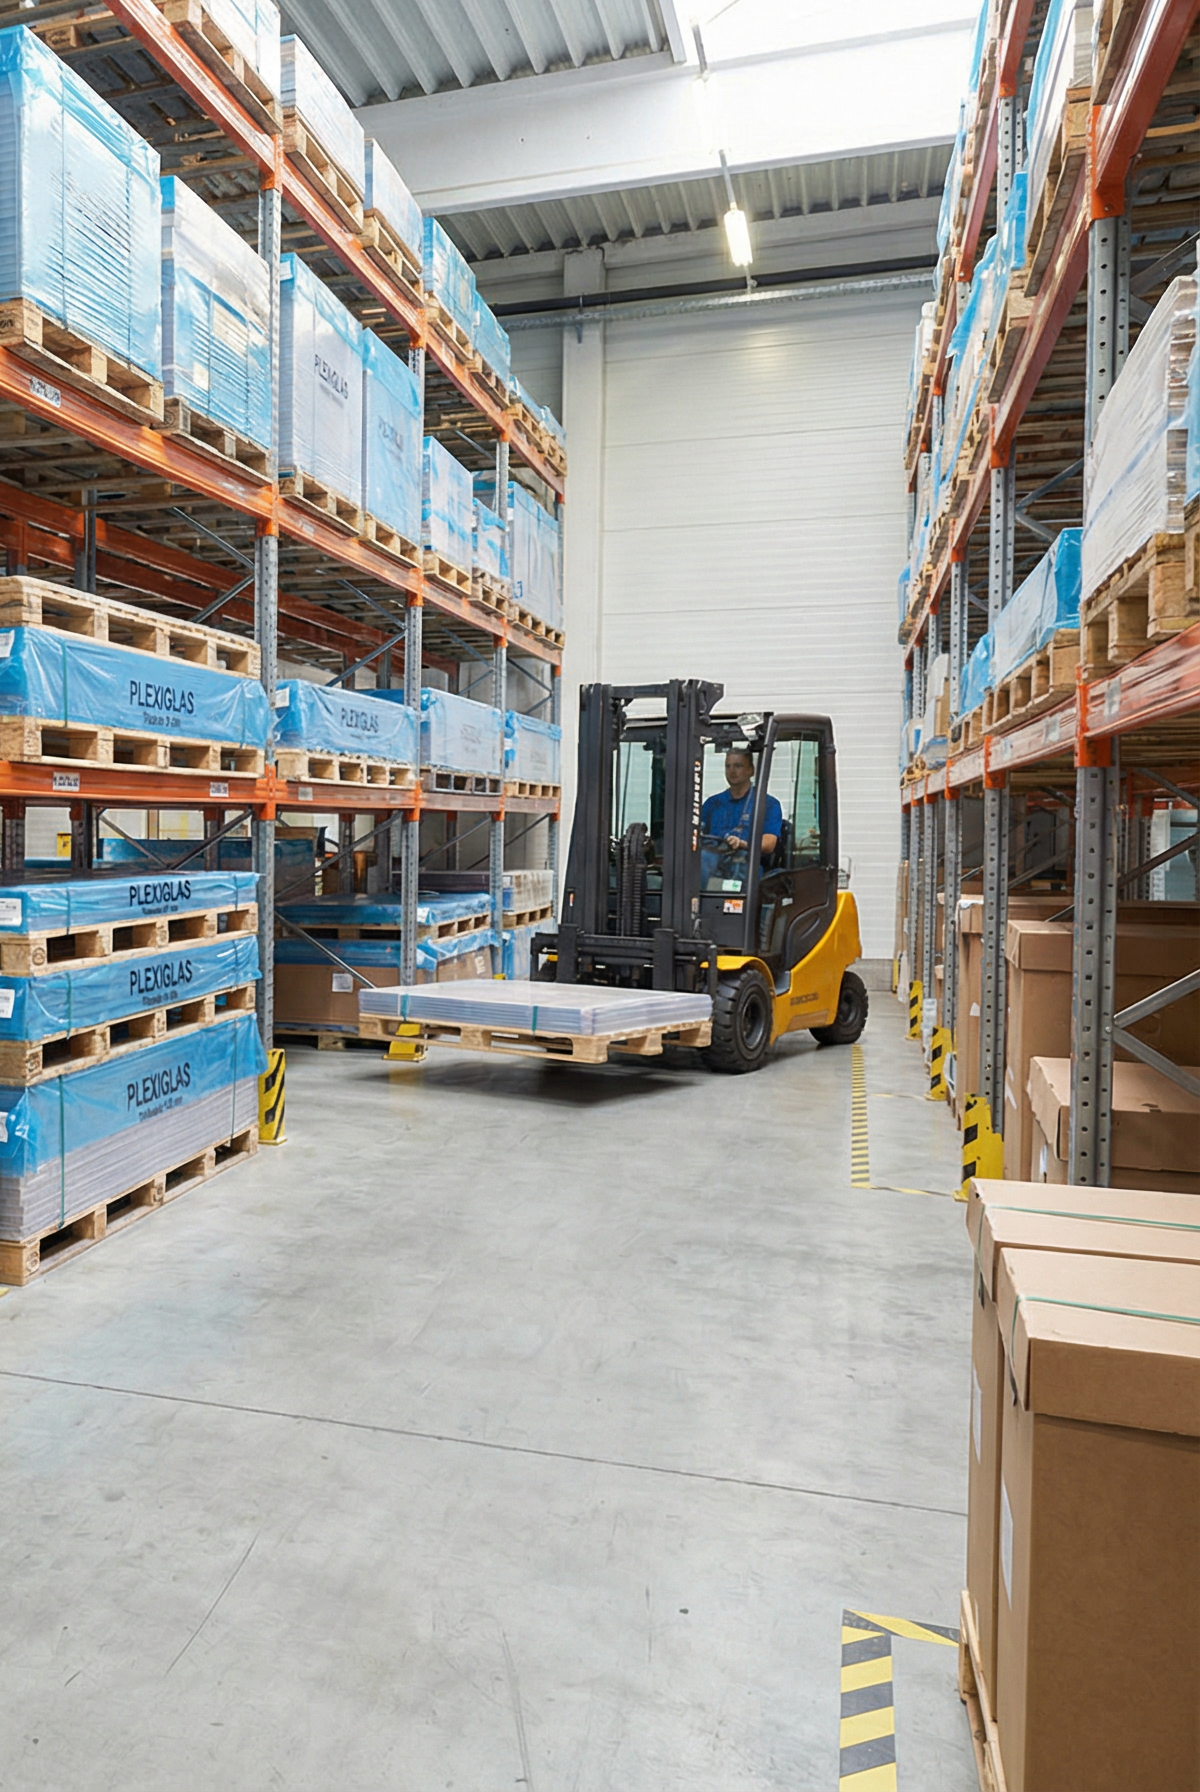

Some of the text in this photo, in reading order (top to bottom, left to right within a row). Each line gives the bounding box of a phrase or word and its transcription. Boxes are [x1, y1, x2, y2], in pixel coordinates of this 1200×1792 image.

[129, 680, 195, 715] PLEXIGLAS
[129, 959, 193, 996] PLEXIGLAS
[126, 1062, 191, 1112] PLEXIGLAS
